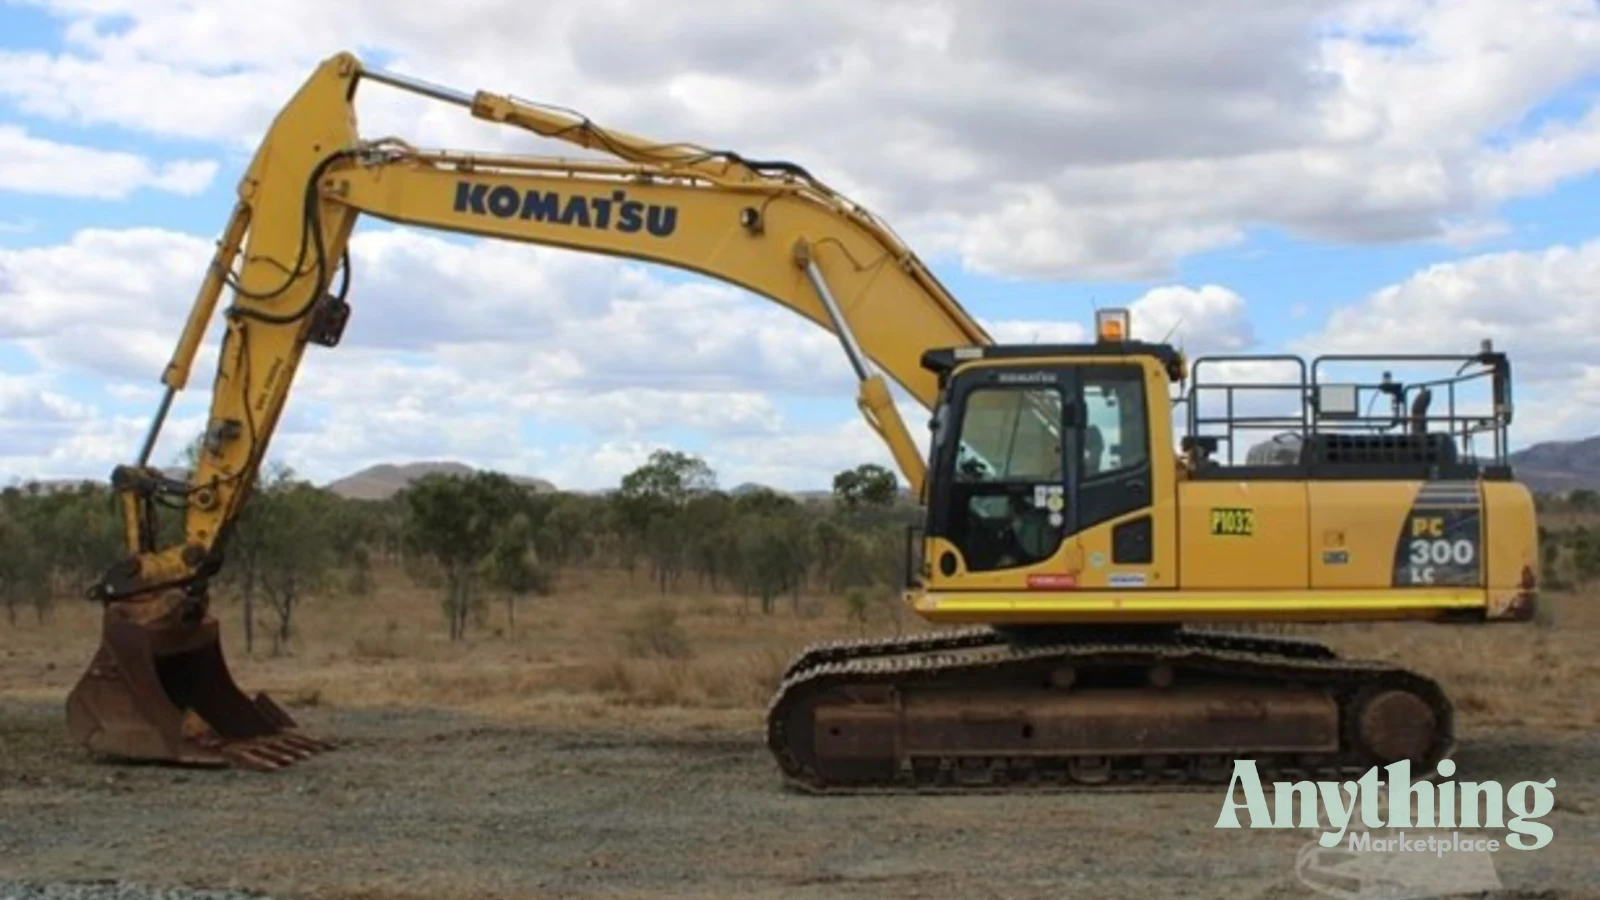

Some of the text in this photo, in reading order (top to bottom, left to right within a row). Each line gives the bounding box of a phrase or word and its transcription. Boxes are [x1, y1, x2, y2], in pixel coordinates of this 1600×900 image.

[454, 181, 677, 237] KOMATSU
[1412, 517, 1443, 537] PC
[1409, 540, 1474, 564] 300
[1411, 567, 1435, 583] LC
